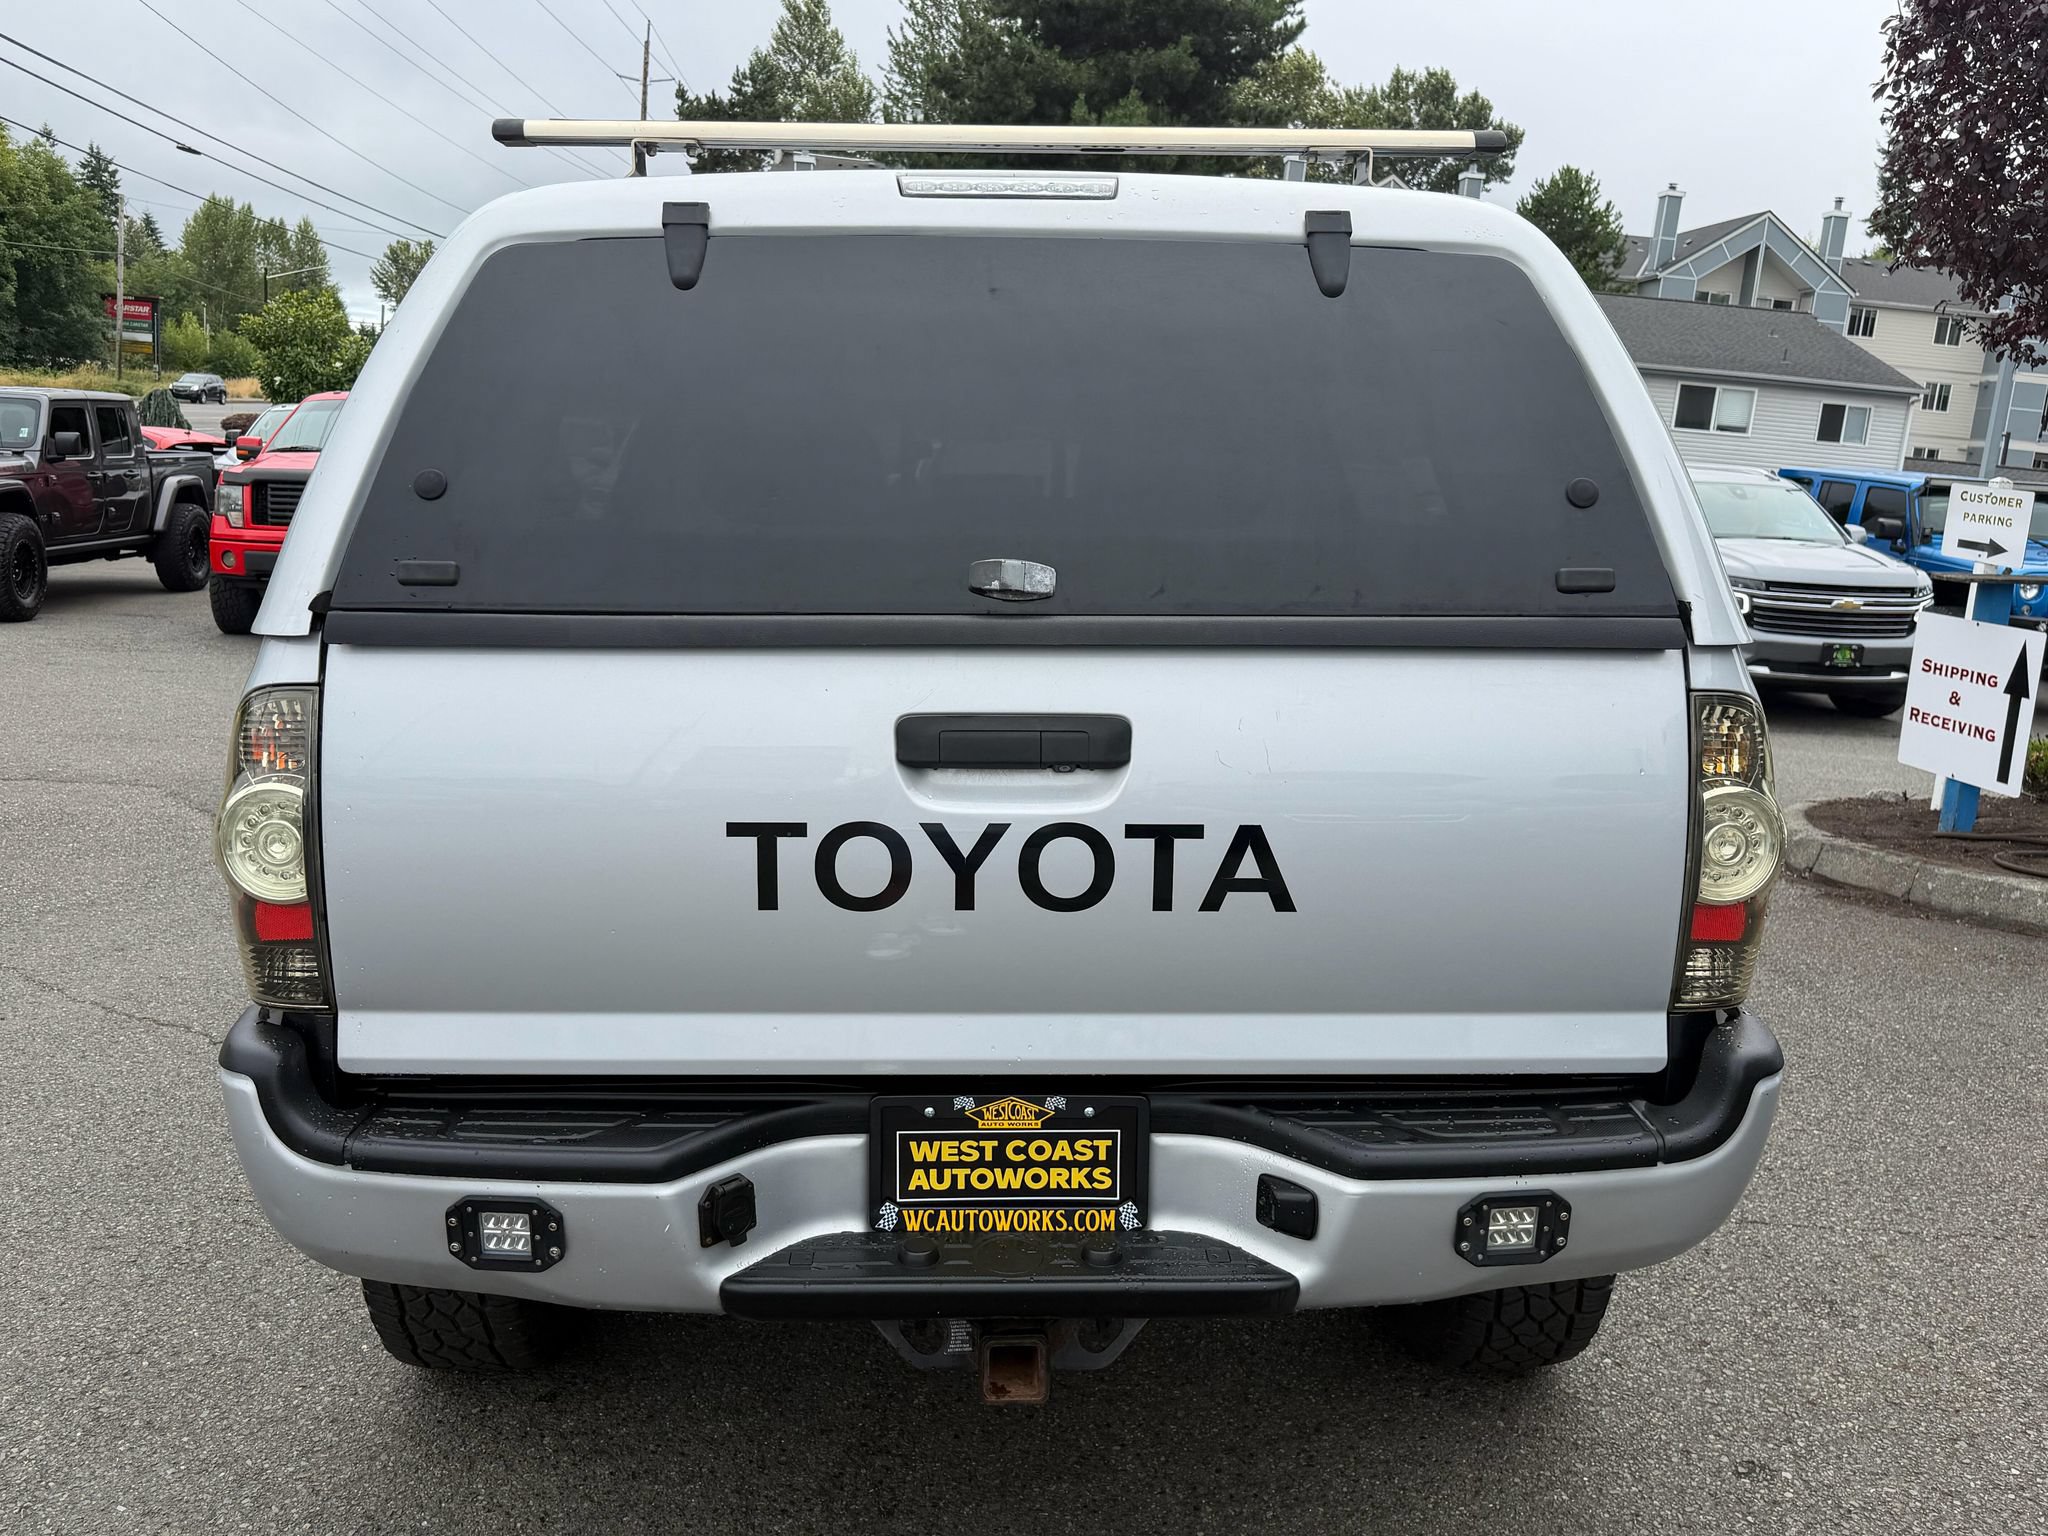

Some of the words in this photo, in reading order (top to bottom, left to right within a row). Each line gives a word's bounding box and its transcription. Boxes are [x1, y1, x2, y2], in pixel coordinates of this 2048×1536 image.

[114, 303, 150, 313] CRSTAR
[1961, 490, 2023, 509] CUSTOMER
[1963, 512, 2013, 528] PARKING
[1922, 658, 1998, 688] SHIPPING
[1948, 691, 1961, 707] &
[1909, 707, 1996, 742] RECEIVING
[726, 821, 1298, 912] TOYOTA
[909, 1140, 998, 1162] WEST
[1005, 1139, 1112, 1162] COAST
[908, 1167, 1113, 1190] AUTOWORKS
[902, 1209, 1116, 1232] WCAUTOWORKS.COM
